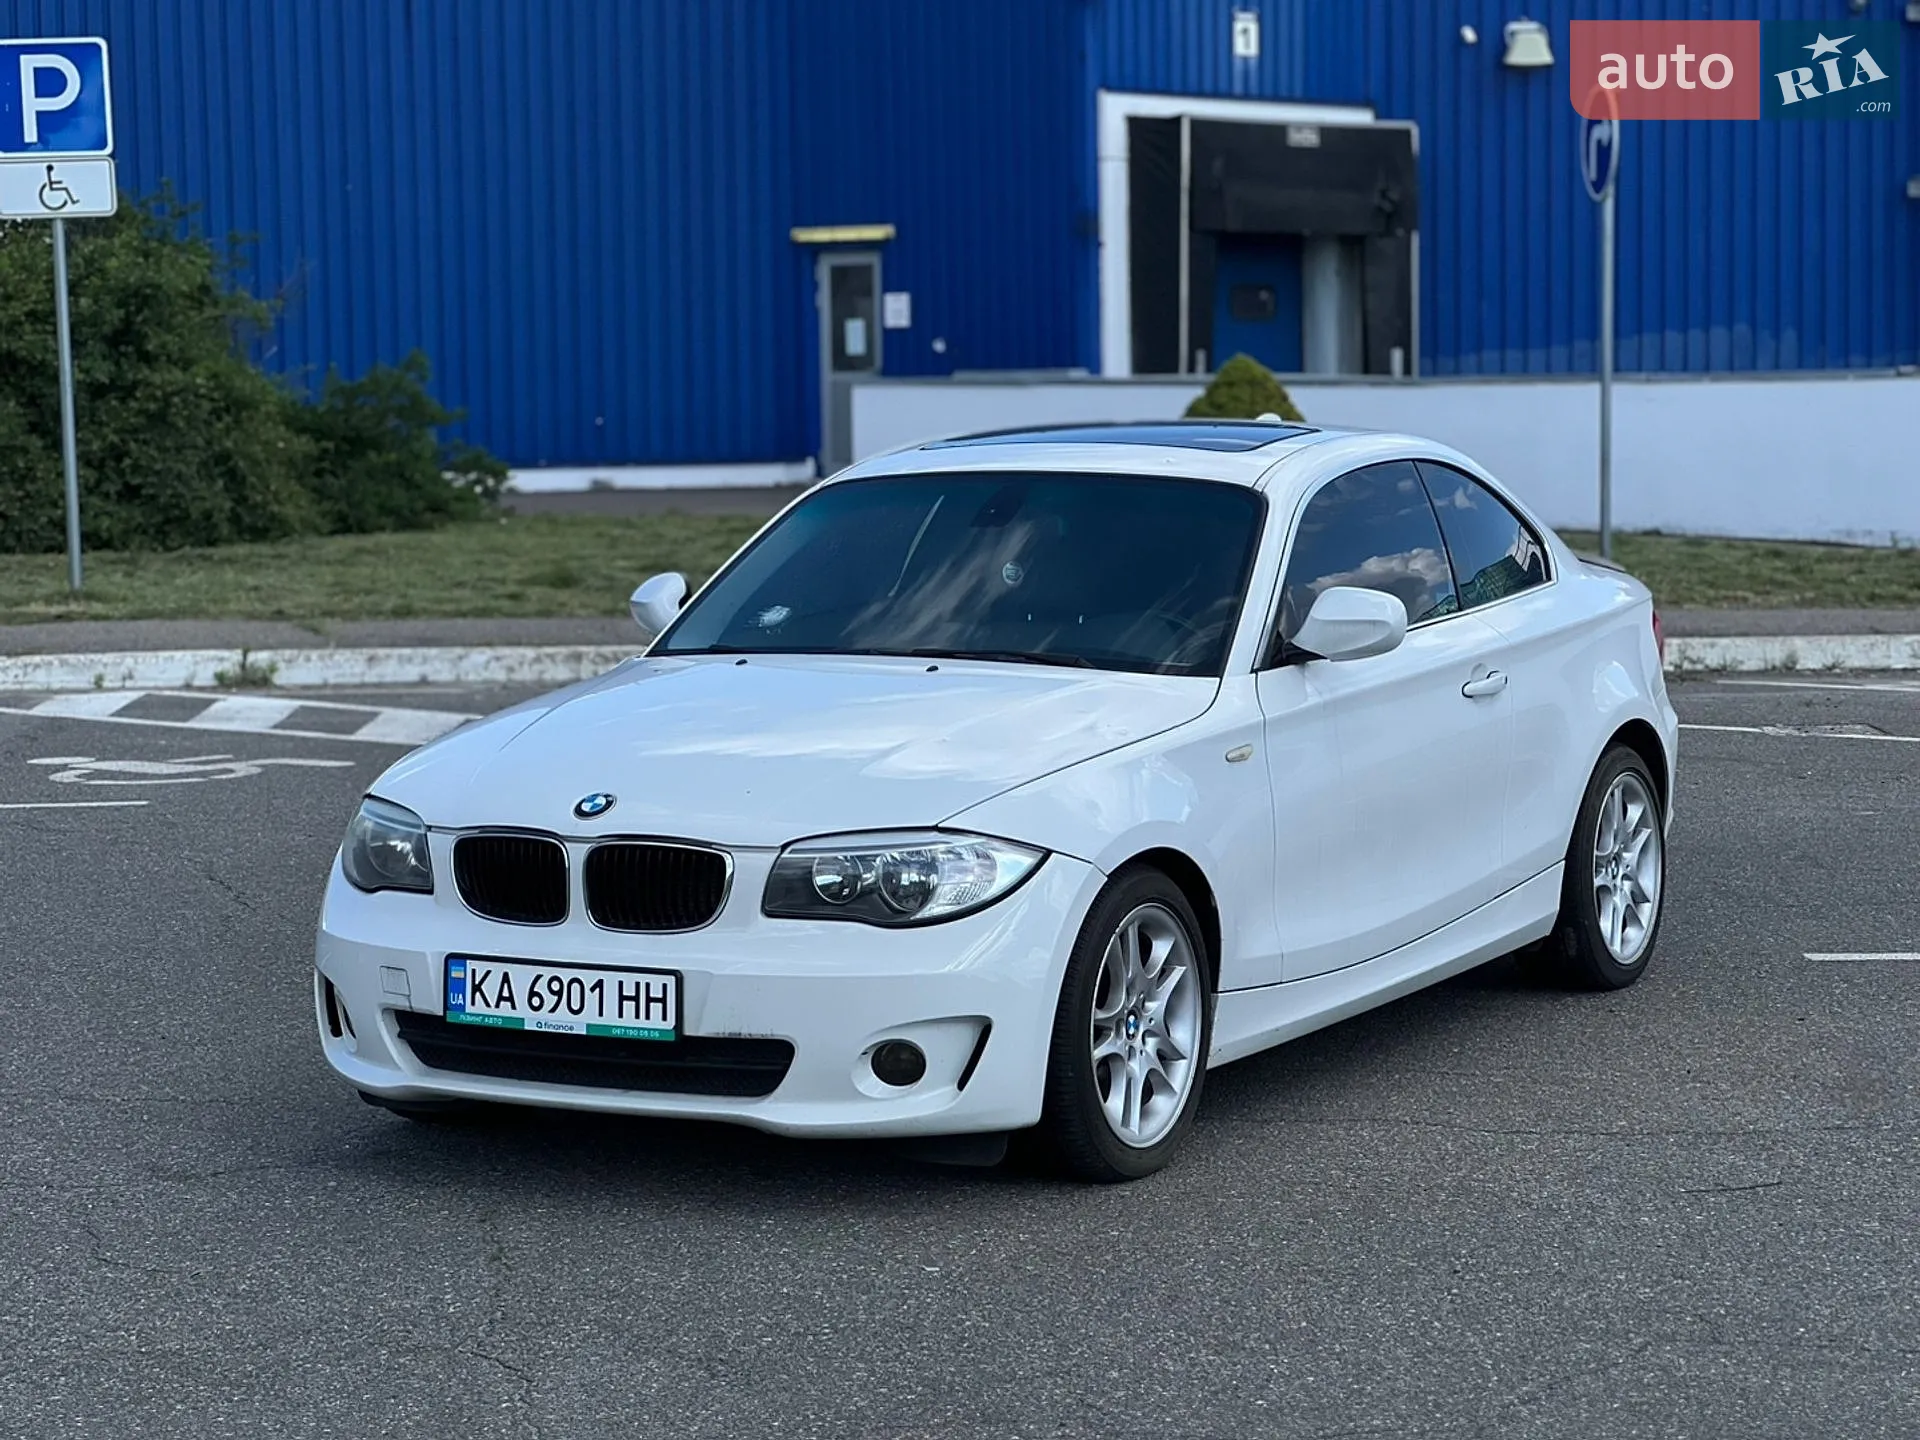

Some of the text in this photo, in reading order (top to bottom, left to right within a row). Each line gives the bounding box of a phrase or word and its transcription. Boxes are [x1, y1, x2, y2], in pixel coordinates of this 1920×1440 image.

[19, 54, 81, 143] P
[450, 992, 464, 1006] UA
[470, 967, 668, 1022] KA 6901 HH
[544, 1021, 575, 1031] finance
